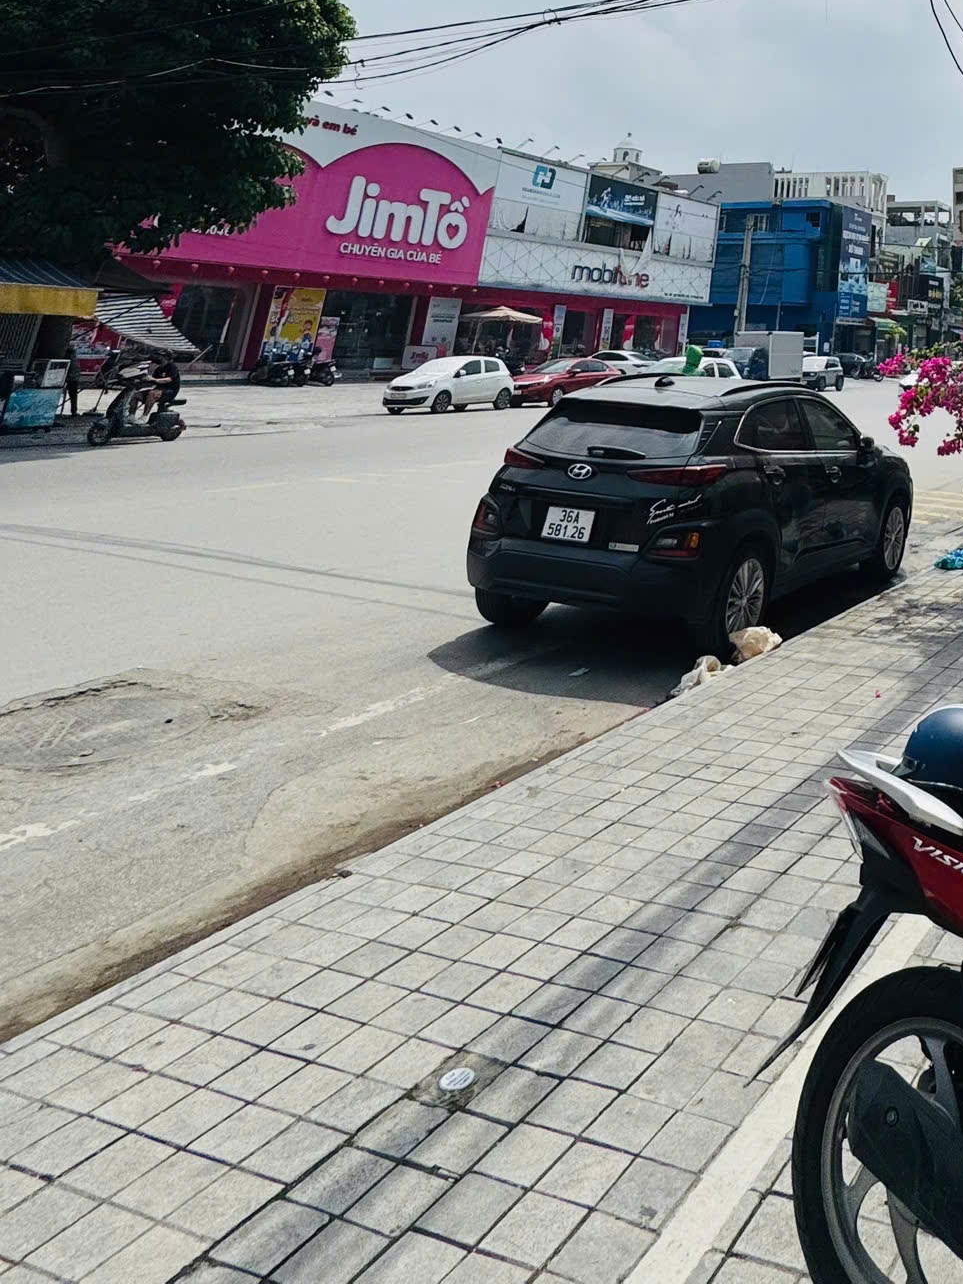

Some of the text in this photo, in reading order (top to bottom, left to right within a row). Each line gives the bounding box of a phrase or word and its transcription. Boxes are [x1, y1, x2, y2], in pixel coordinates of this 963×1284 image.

[322, 121, 341, 132] em
[342, 123, 359, 135] bé
[326, 175, 470, 249] JimTồ
[340, 243, 442, 264] CHUYÊN GIA CỦA BÉ
[559, 509, 580, 524] 36A
[547, 523, 586, 540] 581.26
